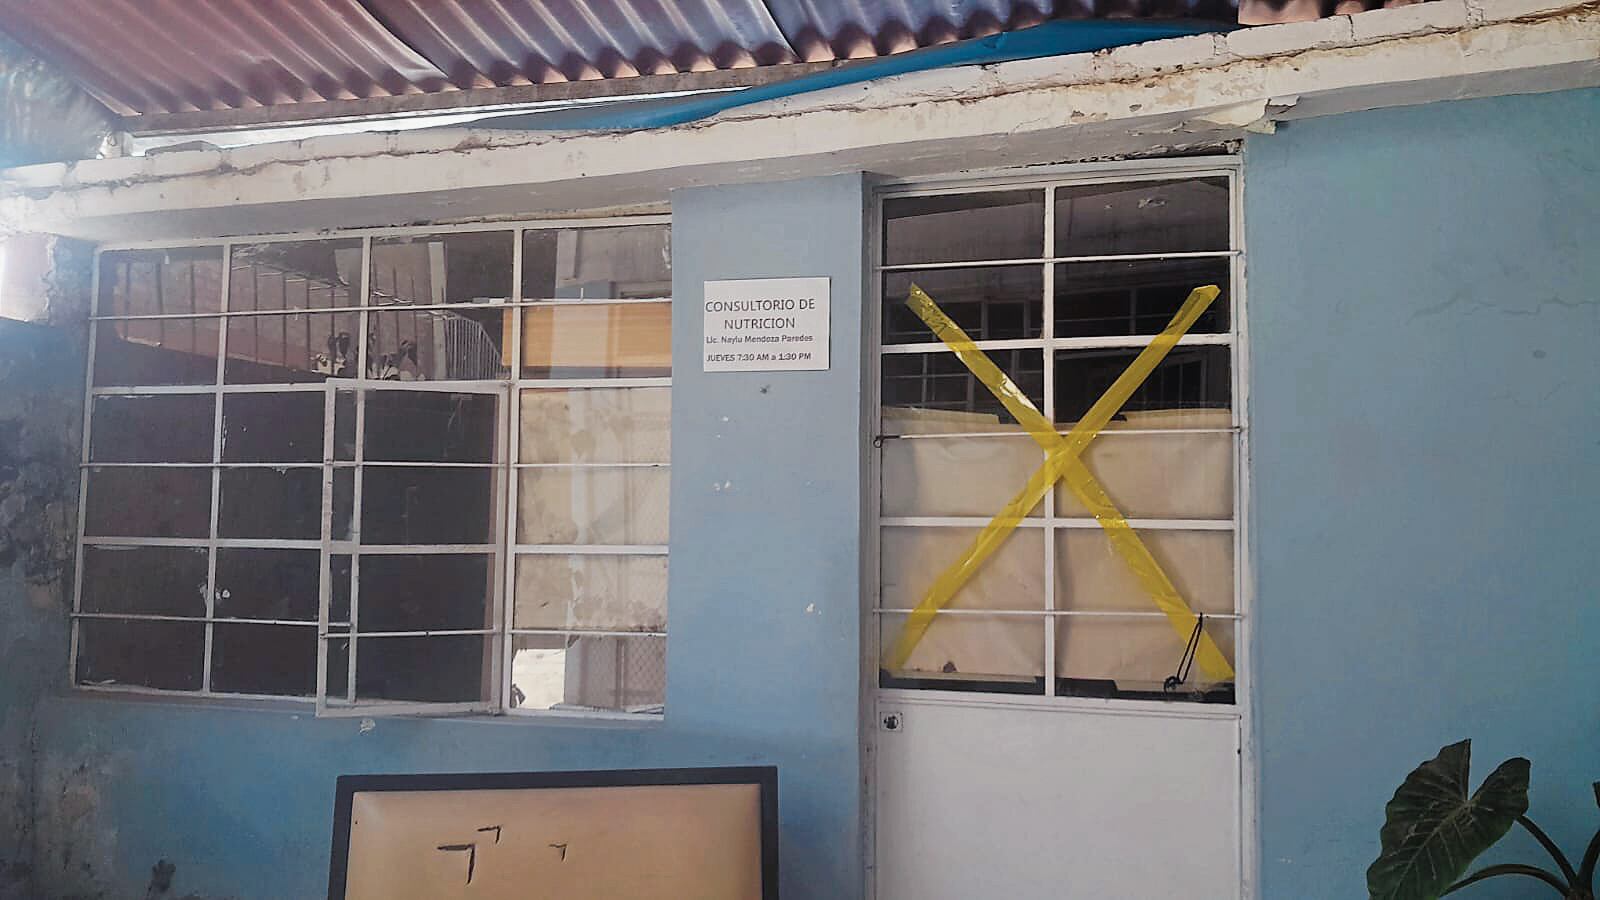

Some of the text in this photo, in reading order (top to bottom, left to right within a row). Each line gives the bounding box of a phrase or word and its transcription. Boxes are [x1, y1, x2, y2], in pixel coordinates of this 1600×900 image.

[705, 299, 815, 312] CONSULTORIO DE
[724, 318, 795, 329] NUTRICION
[706, 336, 719, 344] Lic.
[744, 335, 780, 343] Mendoza
[781, 334, 813, 342] Paredes
[706, 354, 735, 362] JUEVES
[738, 353, 755, 361] 7:30
[756, 353, 770, 361] AM
[779, 352, 797, 360] 1:30
[798, 352, 812, 360] PM
